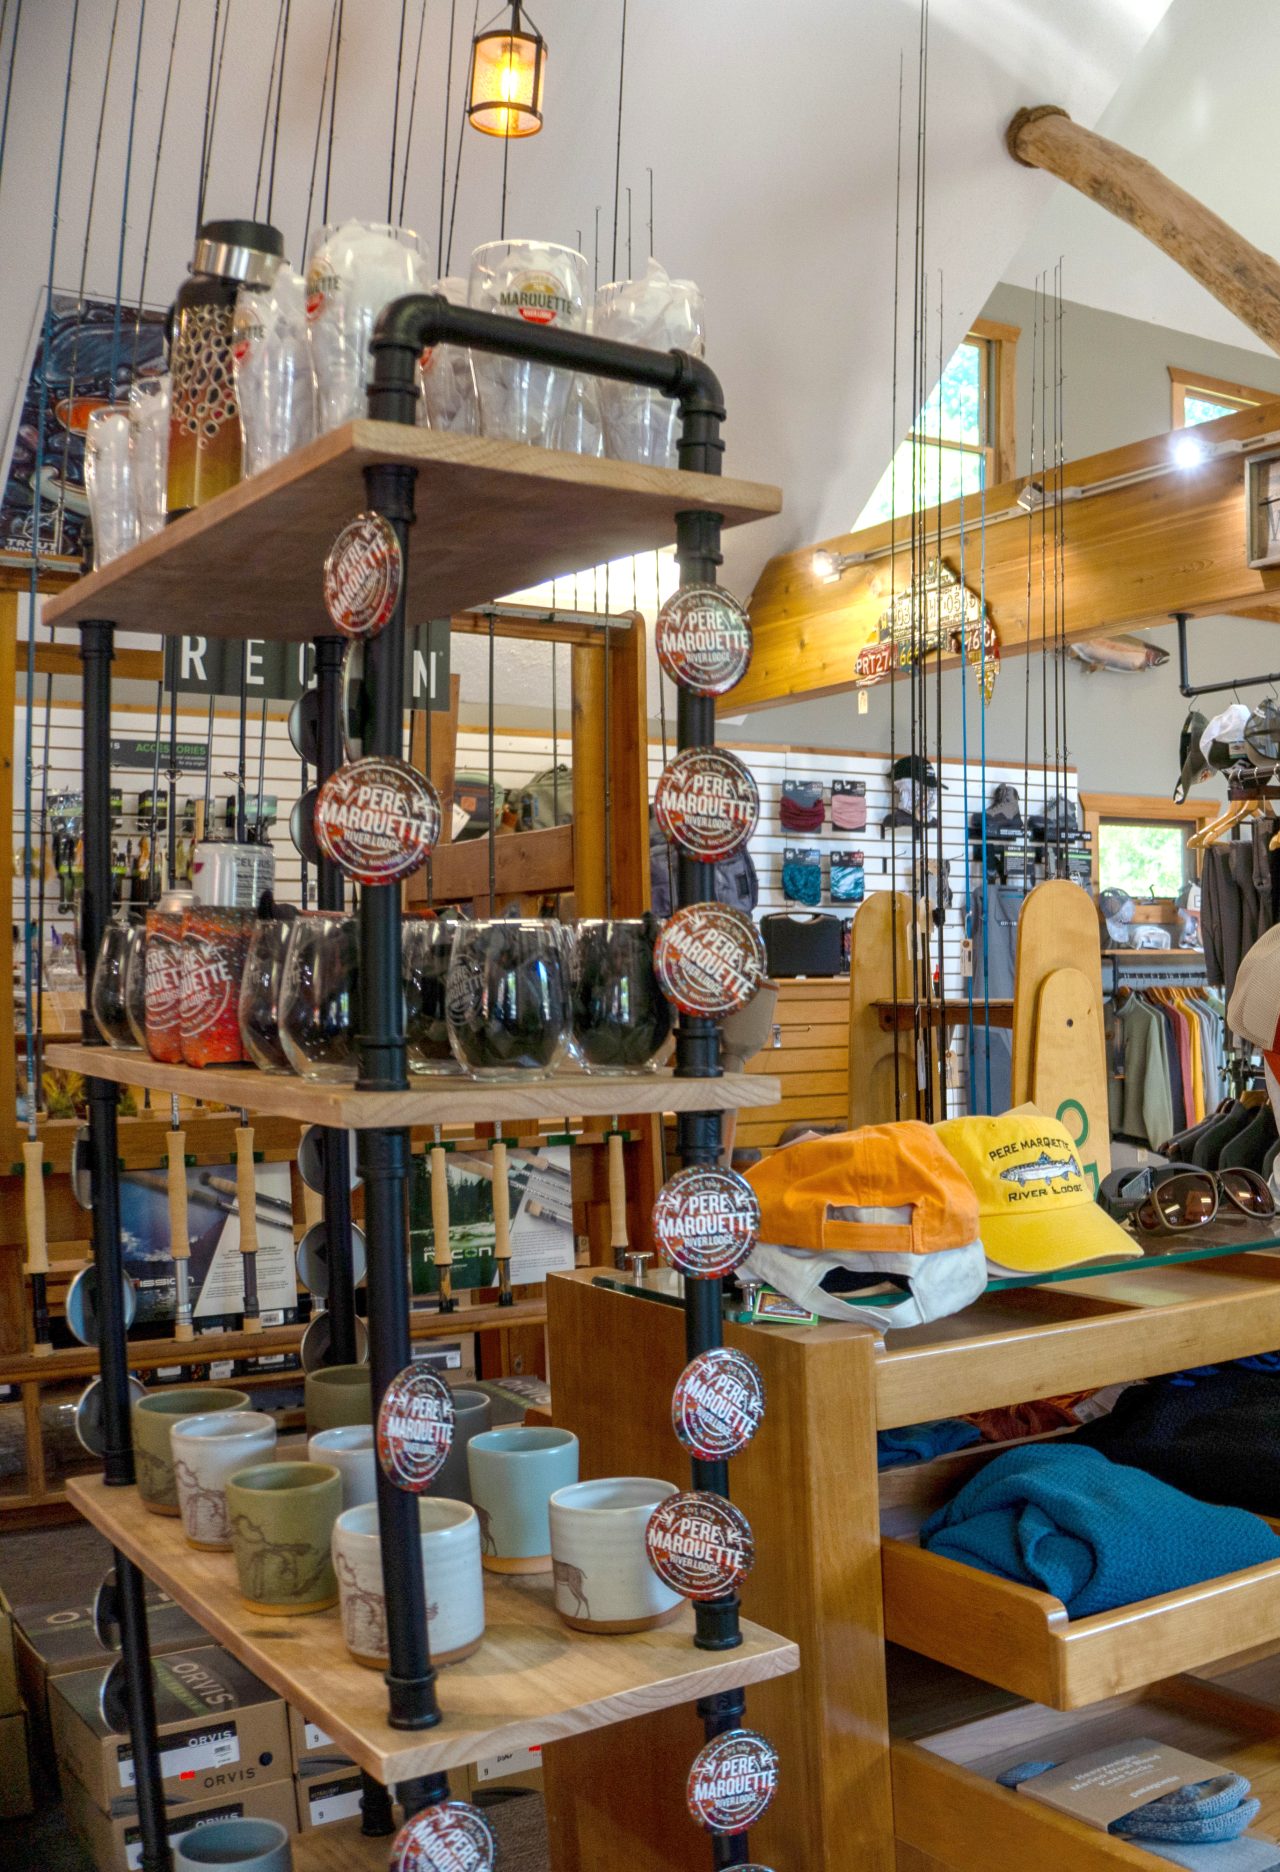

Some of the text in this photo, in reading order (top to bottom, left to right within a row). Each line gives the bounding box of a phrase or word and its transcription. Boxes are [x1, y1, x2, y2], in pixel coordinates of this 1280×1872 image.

[500, 291, 574, 315] MARQUETTE
[688, 610, 725, 630] PERE
[661, 628, 750, 653] MARQUETTE
[693, 773, 733, 798] PERE
[357, 784, 407, 816] PERE
[660, 790, 756, 820] MARQUETTE
[320, 799, 434, 845] MARQUETTE
[703, 928, 745, 967] PERE
[663, 925, 757, 1001] MARQUETTE
[988, 1142, 1019, 1162] PERE
[689, 1193, 730, 1215] PERE
[1008, 1188, 1049, 1203] RIVER
[659, 1211, 756, 1237] MARQUETTE
[715, 1373, 749, 1409] PERE
[412, 1396, 441, 1420] PERE
[683, 1374, 758, 1438] MARQUETTE
[387, 1417, 454, 1445] MARQUETTE
[680, 1517, 722, 1544] PERE
[648, 1528, 746, 1569] MARQUETTE
[669, 1554, 720, 1574] RIVER LODGE
[172, 1662, 235, 1705] ORVIS
[188, 1730, 233, 1749] ORVIS
[204, 1767, 257, 1789] ORVIS
[722, 1755, 757, 1778] PERE
[694, 1769, 777, 1802] MARQUETTE
[1129, 1775, 1181, 1799] patagonia
